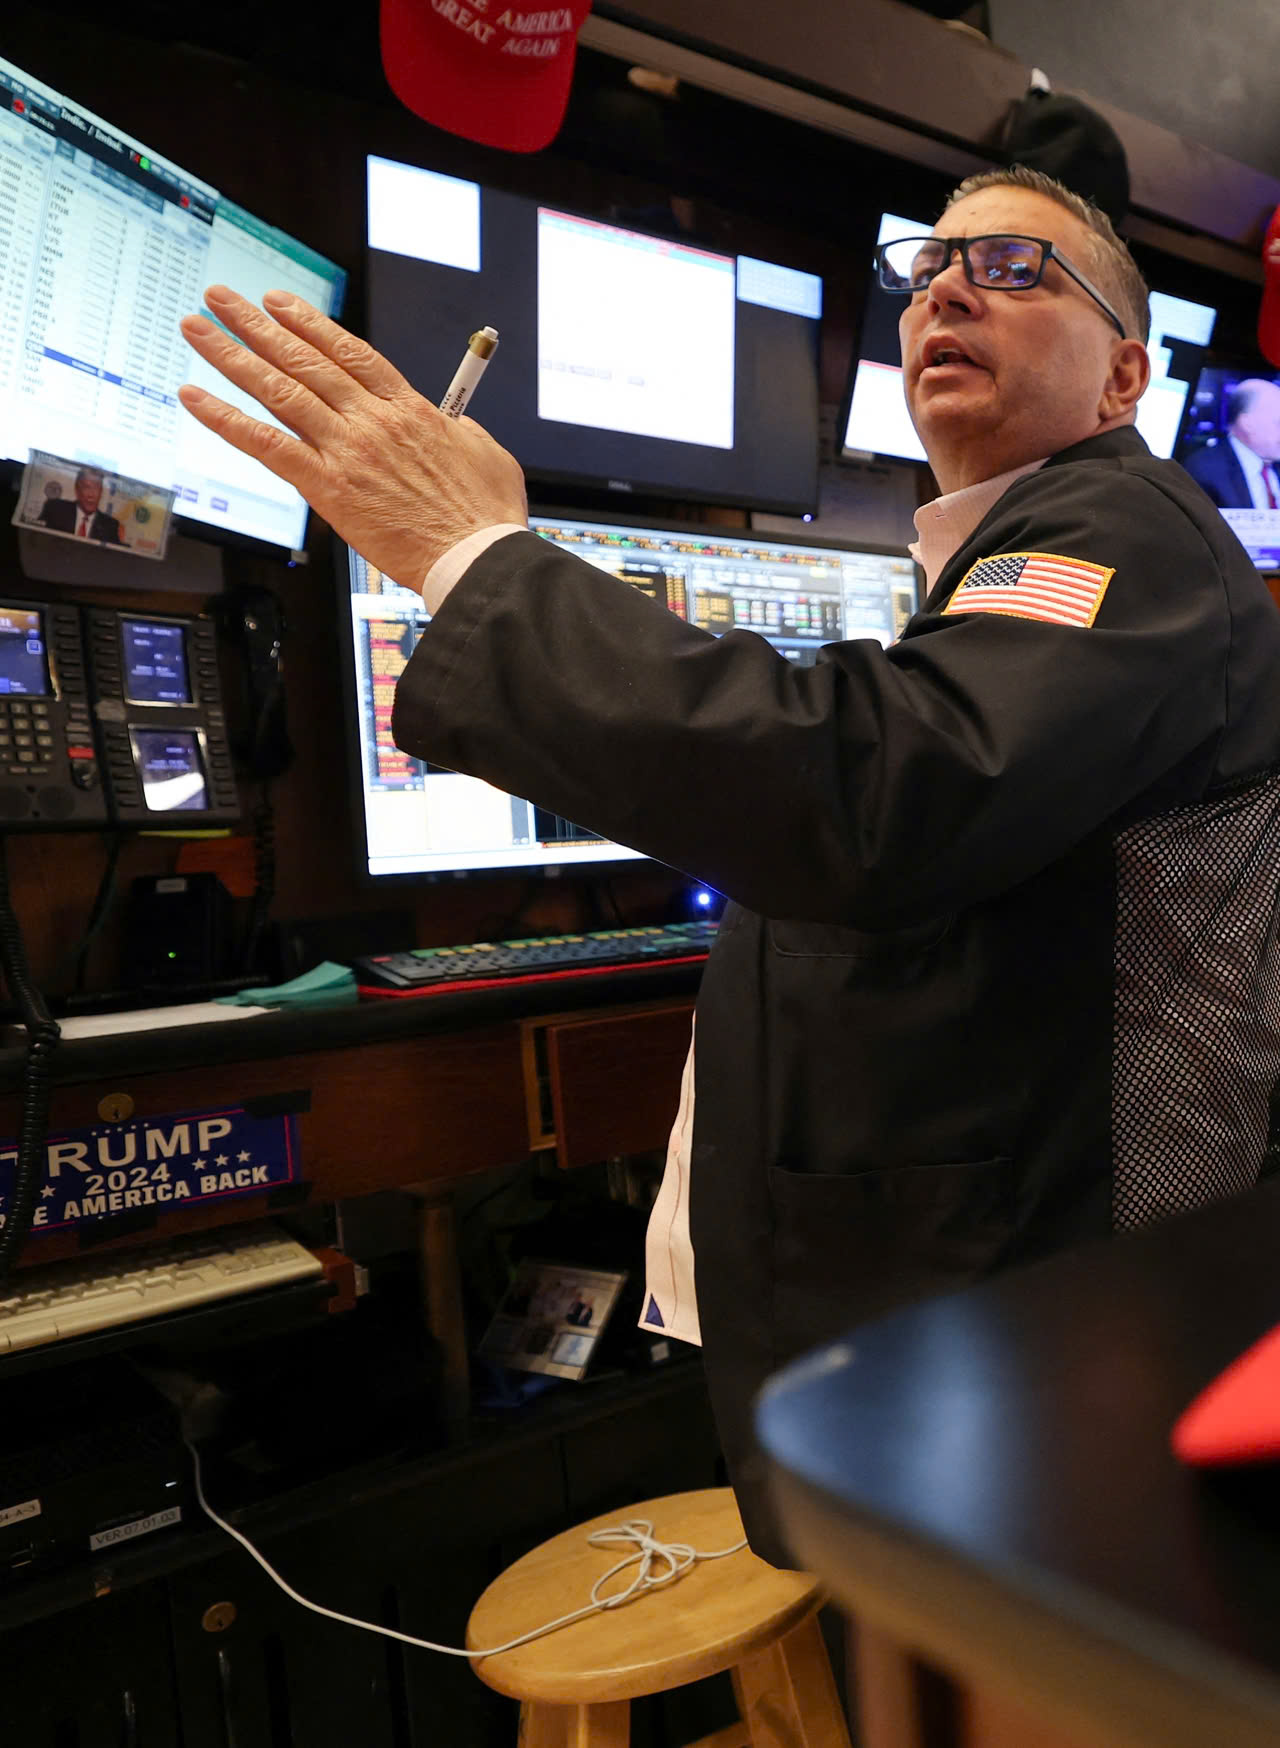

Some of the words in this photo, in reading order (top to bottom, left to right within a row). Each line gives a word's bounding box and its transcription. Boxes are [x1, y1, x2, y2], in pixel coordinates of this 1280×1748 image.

[496, 8, 572, 33] AMERICA
[500, 37, 560, 57] AGAIN
[63, 1180, 191, 1220] AMERICA
[200, 1165, 269, 1194] BACK
[85, 1163, 171, 1196] 2024
